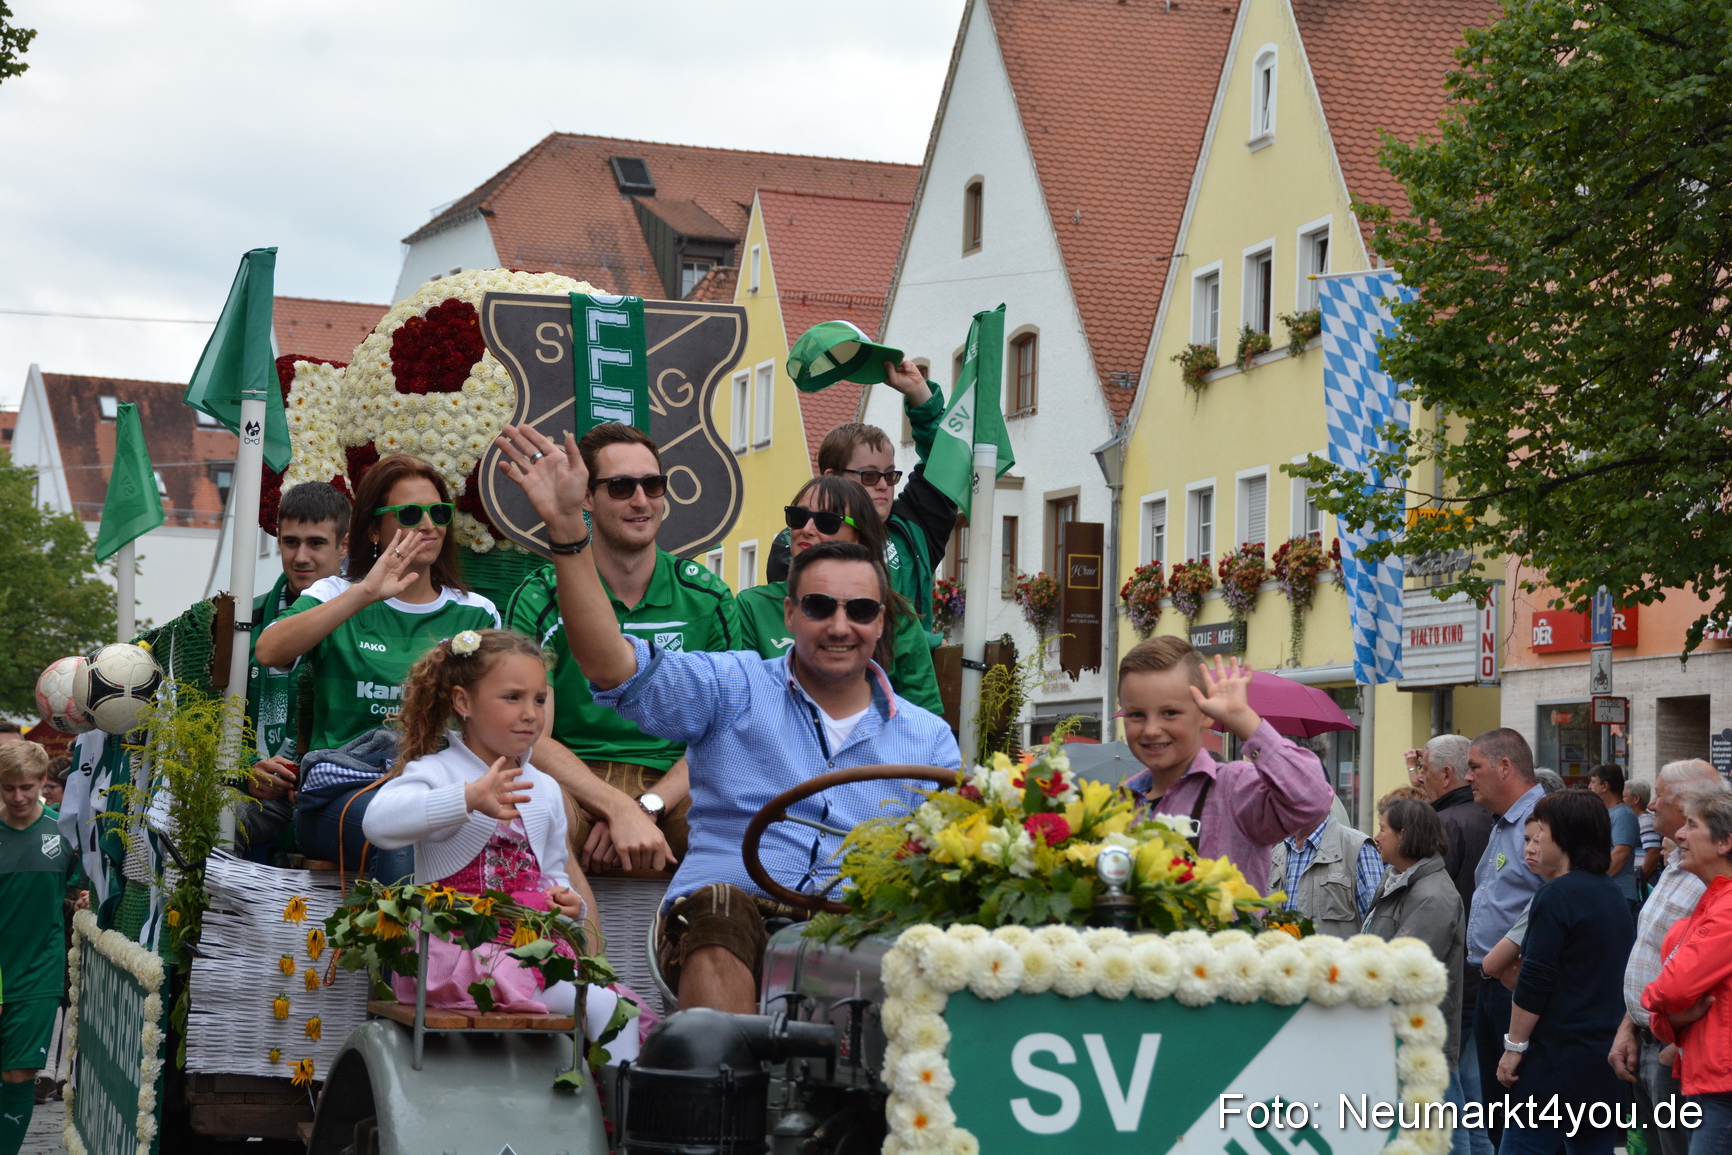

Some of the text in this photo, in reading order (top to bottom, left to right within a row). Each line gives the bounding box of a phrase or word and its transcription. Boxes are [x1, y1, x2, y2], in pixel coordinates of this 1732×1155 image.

[947, 405, 971, 433] SV
[656, 635, 670, 644] SV
[1191, 631, 1212, 647] WOLLE
[1218, 629, 1234, 644] MEH
[1411, 624, 1463, 647] RIALTO KINO
[359, 641, 387, 653] JAKO
[267, 726, 282, 745] SV
[116, 978, 144, 1090] VERDE
[1010, 1031, 1162, 1135] SV
